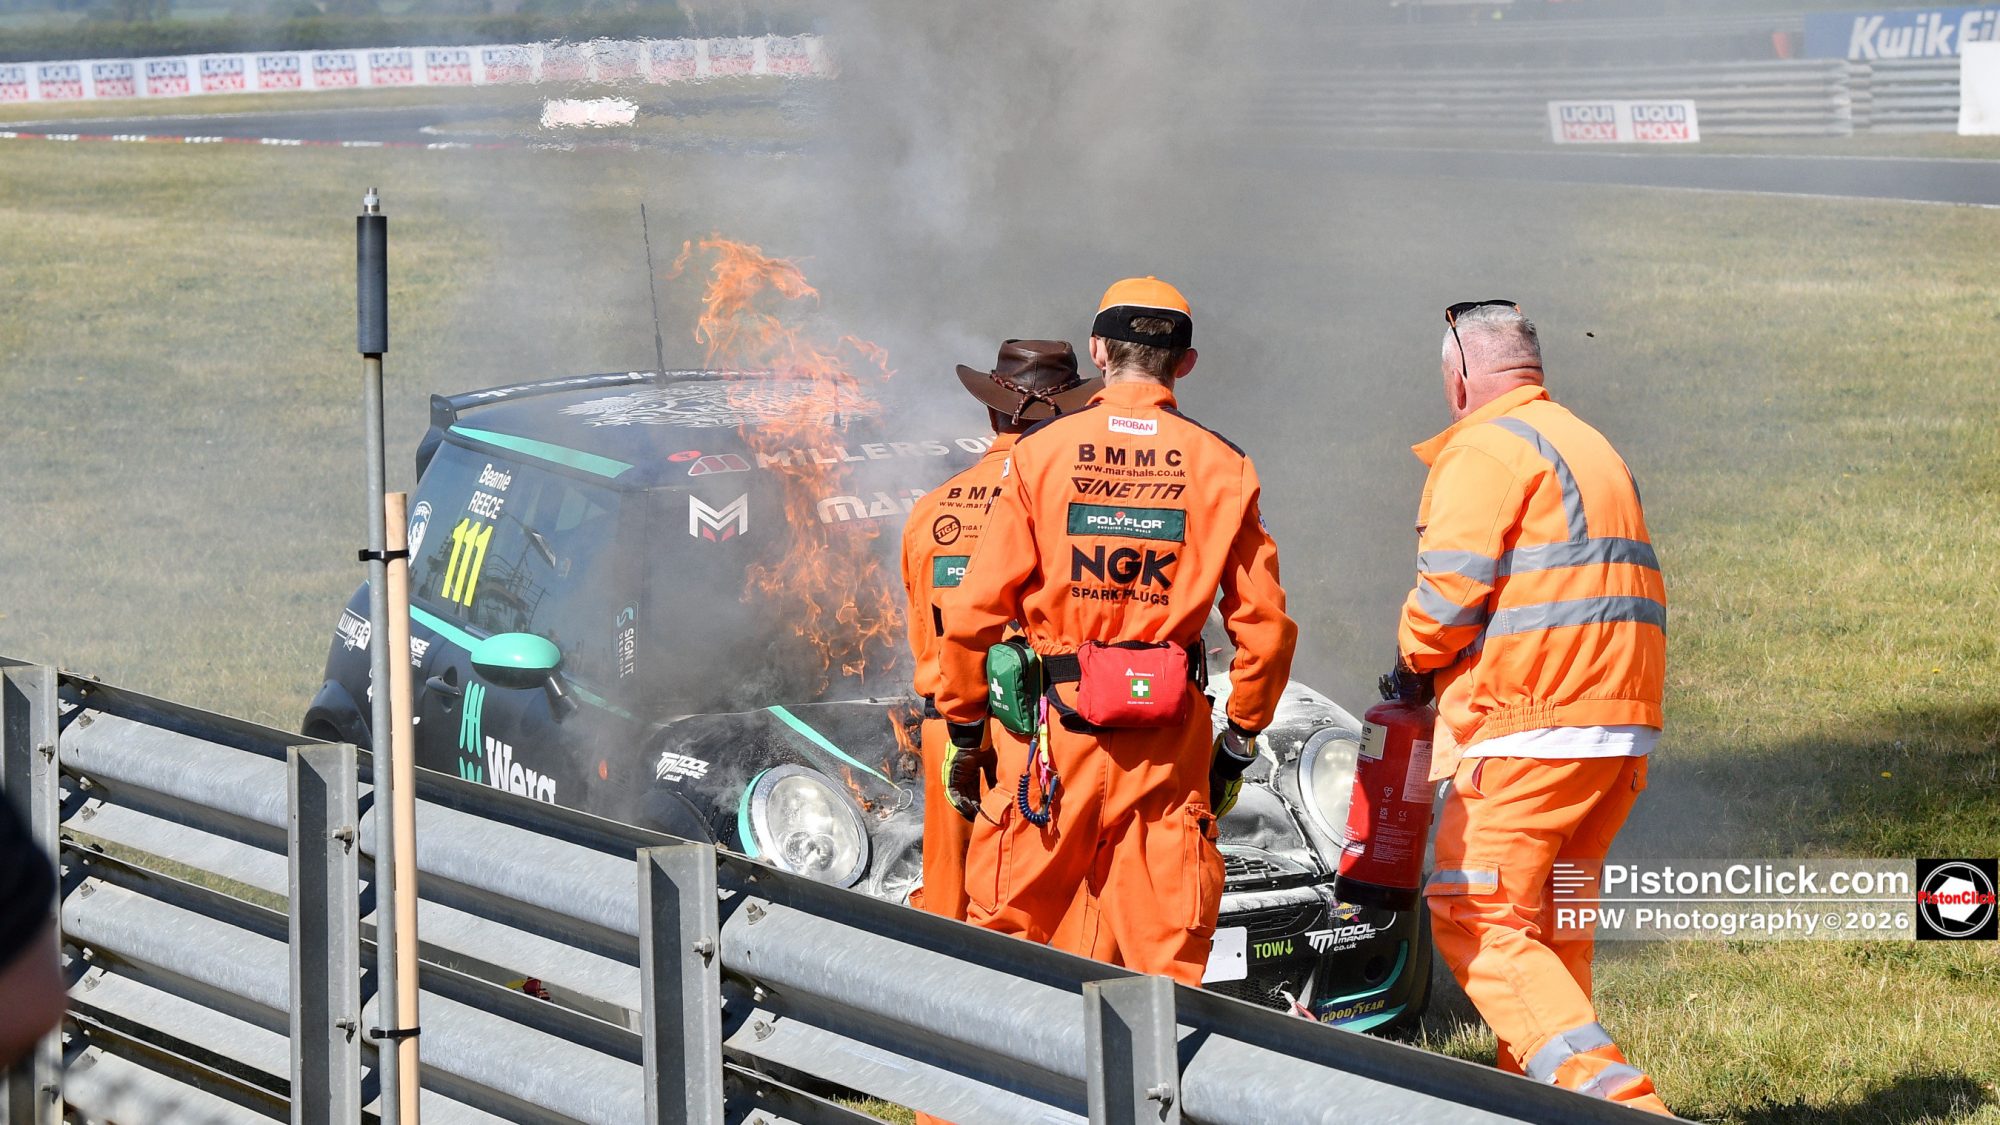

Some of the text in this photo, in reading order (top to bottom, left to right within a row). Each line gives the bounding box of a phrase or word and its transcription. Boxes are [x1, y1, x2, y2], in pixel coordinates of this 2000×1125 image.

[1848, 9, 2000, 60] Kwik Fi
[1562, 106, 1613, 122] LIQUI
[1634, 105, 1685, 121] LIQUI
[1564, 122, 1616, 138] MOLY
[1635, 122, 1688, 138] MOLY
[1112, 418, 1153, 431] PROBAN
[756, 441, 950, 468] MILLERS
[478, 463, 511, 491] Beanie
[1074, 464, 1186, 477] www.marshals.co.uk
[1071, 477, 1186, 500] GINETTA
[467, 490, 504, 519] REECE
[940, 501, 989, 509] www.mar
[936, 520, 960, 540] TIGA
[1087, 514, 1162, 529] POLYFLOR
[441, 518, 493, 607] 111
[1071, 544, 1178, 591] NGK
[947, 567, 966, 576] PO
[1071, 587, 1170, 606] SPARK PLUGS
[624, 627, 634, 675] SIGN IT
[1330, 904, 1362, 918] SUNOCO
[1333, 923, 1376, 943] TOOL
[1337, 932, 1376, 943] MANIAC
[1253, 940, 1285, 958] TOW
[1333, 942, 1357, 952] co.uk
